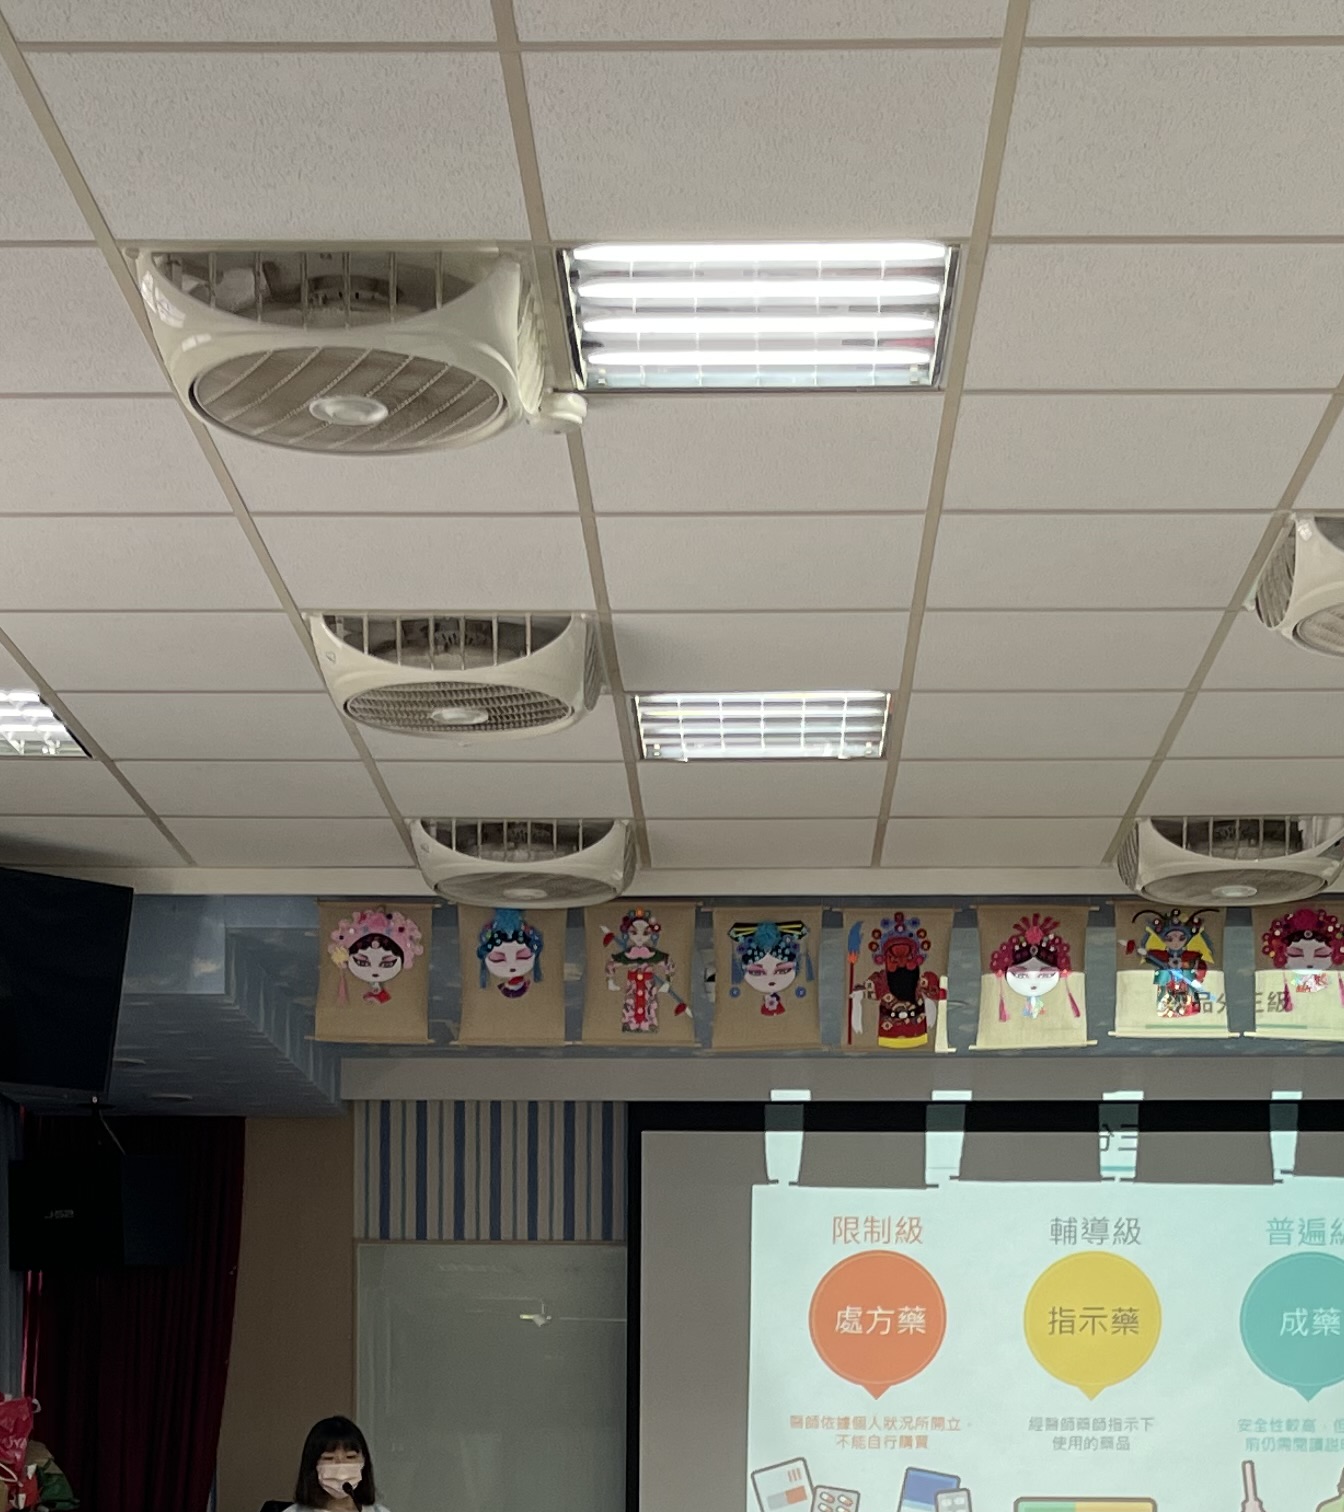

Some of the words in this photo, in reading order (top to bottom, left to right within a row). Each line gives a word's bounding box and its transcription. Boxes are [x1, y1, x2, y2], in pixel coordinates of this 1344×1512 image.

[832, 1216, 923, 1245] 限制級
[1050, 1217, 1142, 1246] 輔導級
[835, 1305, 927, 1335] 處方藥
[1048, 1306, 1140, 1336] 指示藥
[1280, 1307, 1342, 1337] 成藥
[836, 1435, 929, 1450] 不能自行購買
[1052, 1436, 1130, 1451] 使用的藥品
